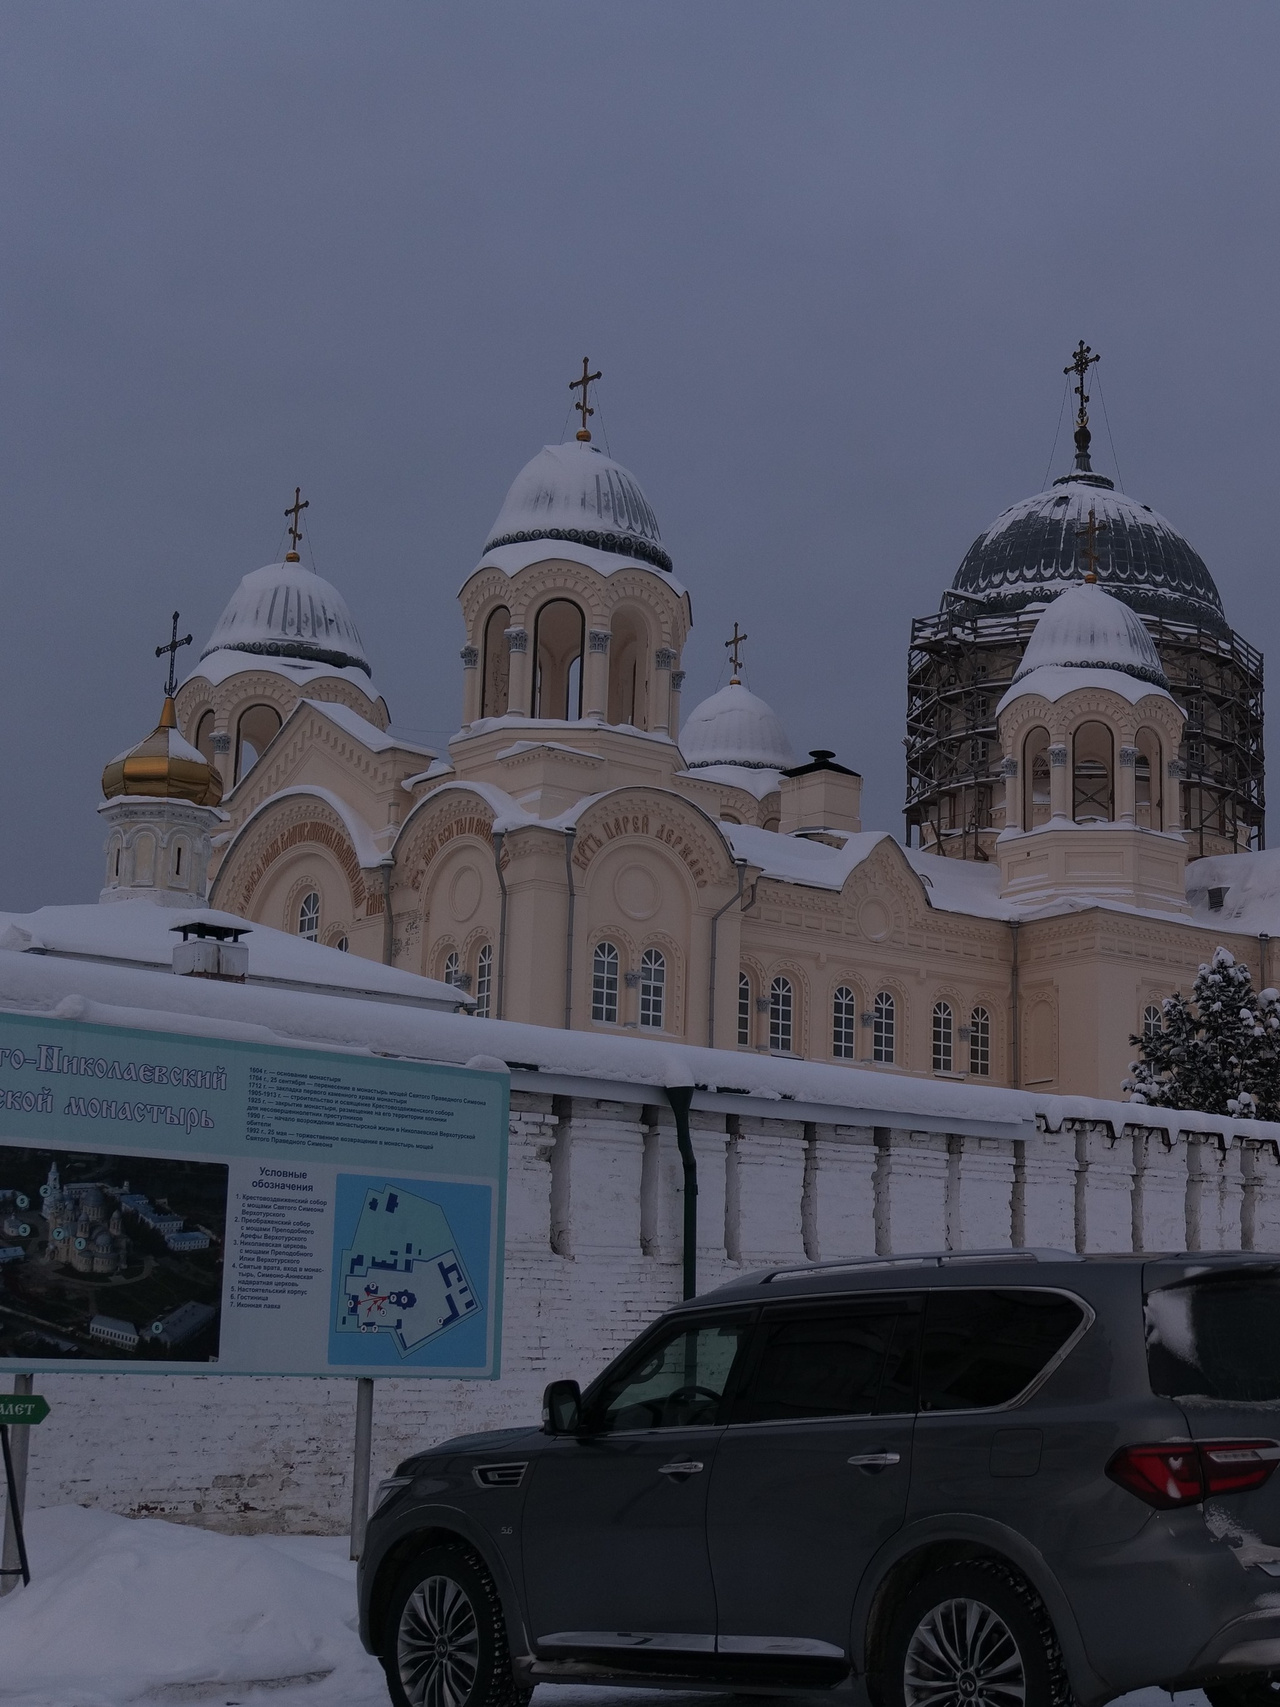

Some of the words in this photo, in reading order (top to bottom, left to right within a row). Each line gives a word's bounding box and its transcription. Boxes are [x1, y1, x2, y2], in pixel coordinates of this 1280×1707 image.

[277, 1071, 307, 1079] основание
[64, 1096, 215, 1134] монастырь
[260, 1167, 307, 1179] Условные
[252, 1180, 313, 1192] обозначения
